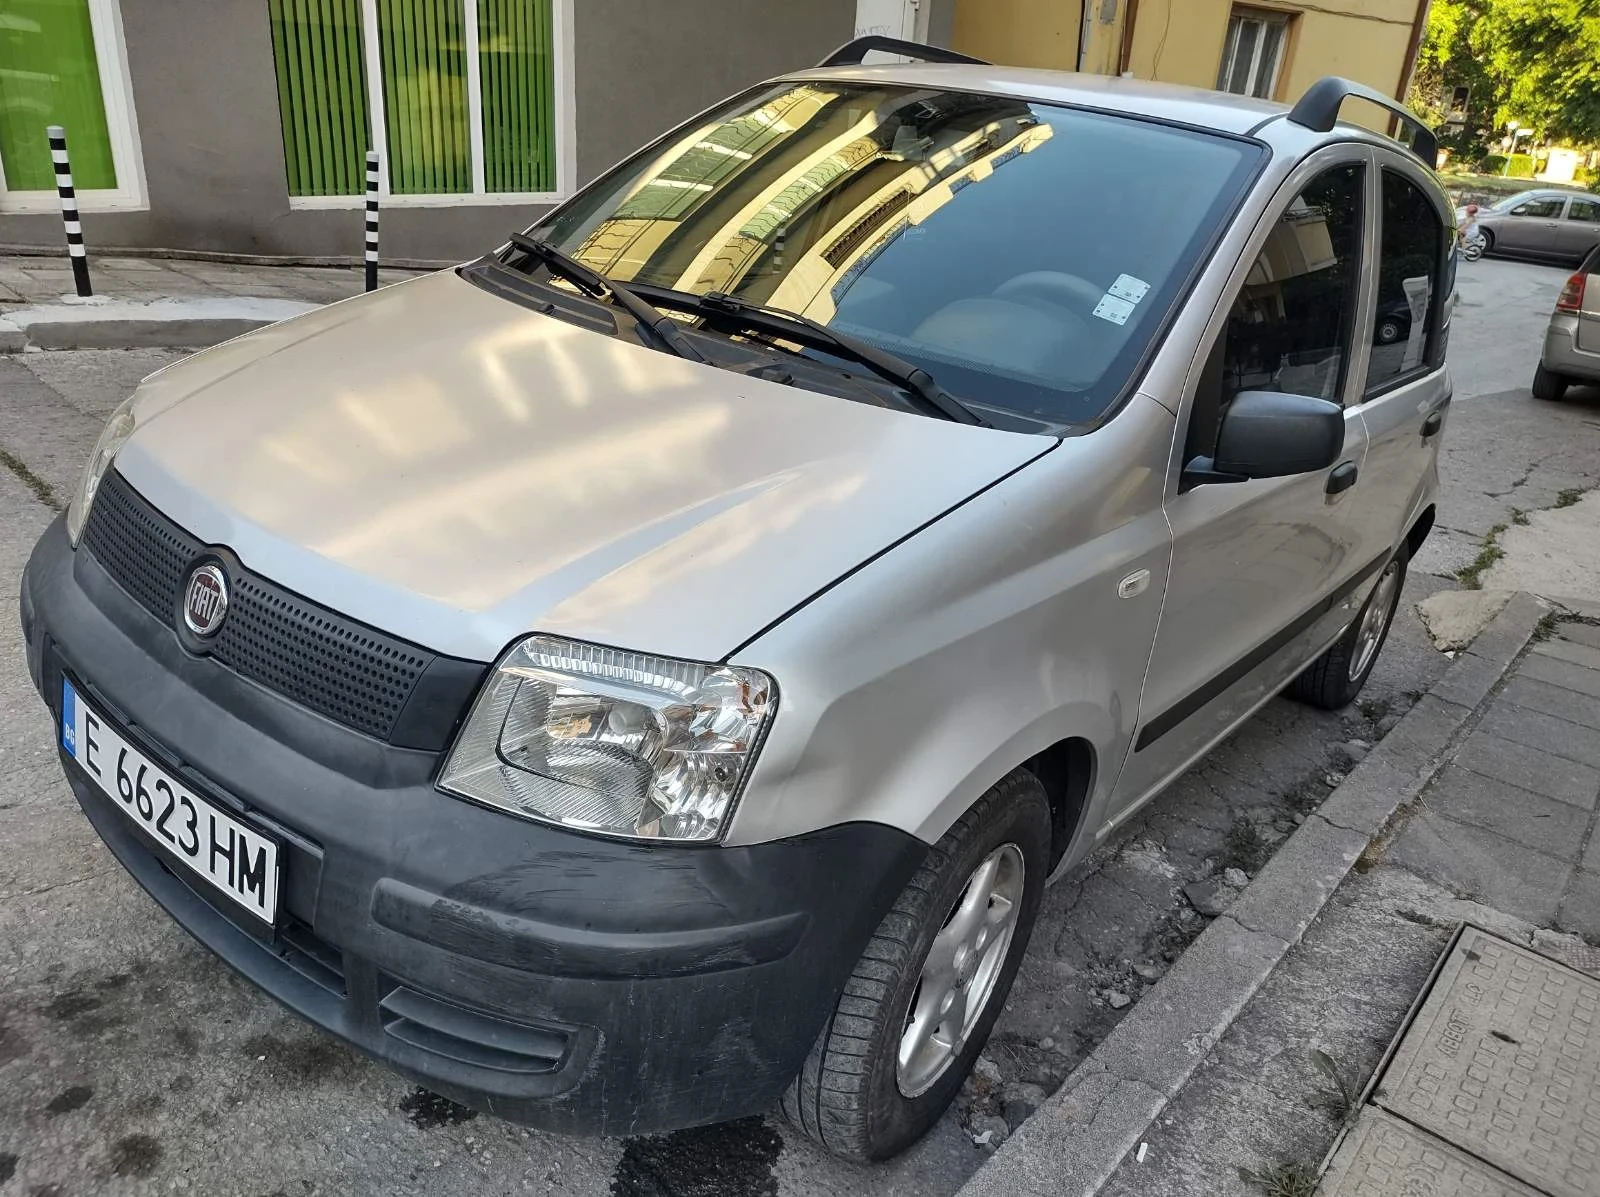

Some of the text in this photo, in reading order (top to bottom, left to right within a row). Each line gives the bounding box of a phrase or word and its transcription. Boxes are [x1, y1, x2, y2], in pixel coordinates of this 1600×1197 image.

[190, 581, 219, 621] FIAT
[65, 722, 75, 746] BG
[85, 711, 267, 909] E 6623 HM
